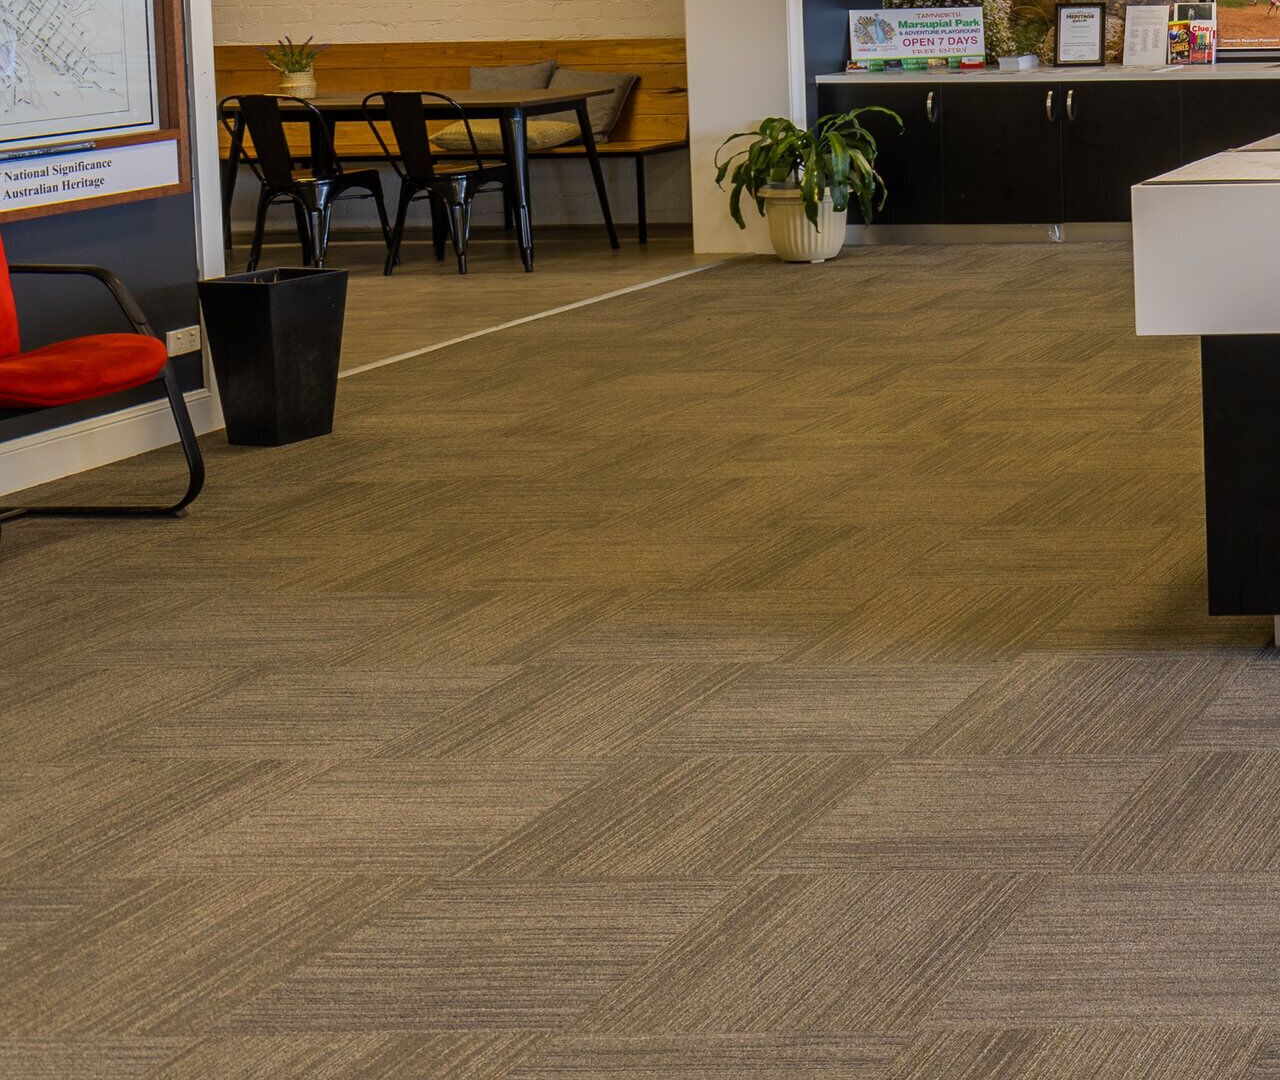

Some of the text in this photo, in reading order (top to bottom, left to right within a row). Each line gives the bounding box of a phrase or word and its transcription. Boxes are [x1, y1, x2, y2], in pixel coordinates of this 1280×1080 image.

[915, 11, 961, 19] TAMWORTH
[898, 18, 980, 29] Marsupial Park
[902, 36, 978, 47] OPEN 7 DAYS
[939, 47, 968, 55] ENTRY
[4, 158, 113, 182] National Significance
[3, 176, 105, 200] Australian Heritage
